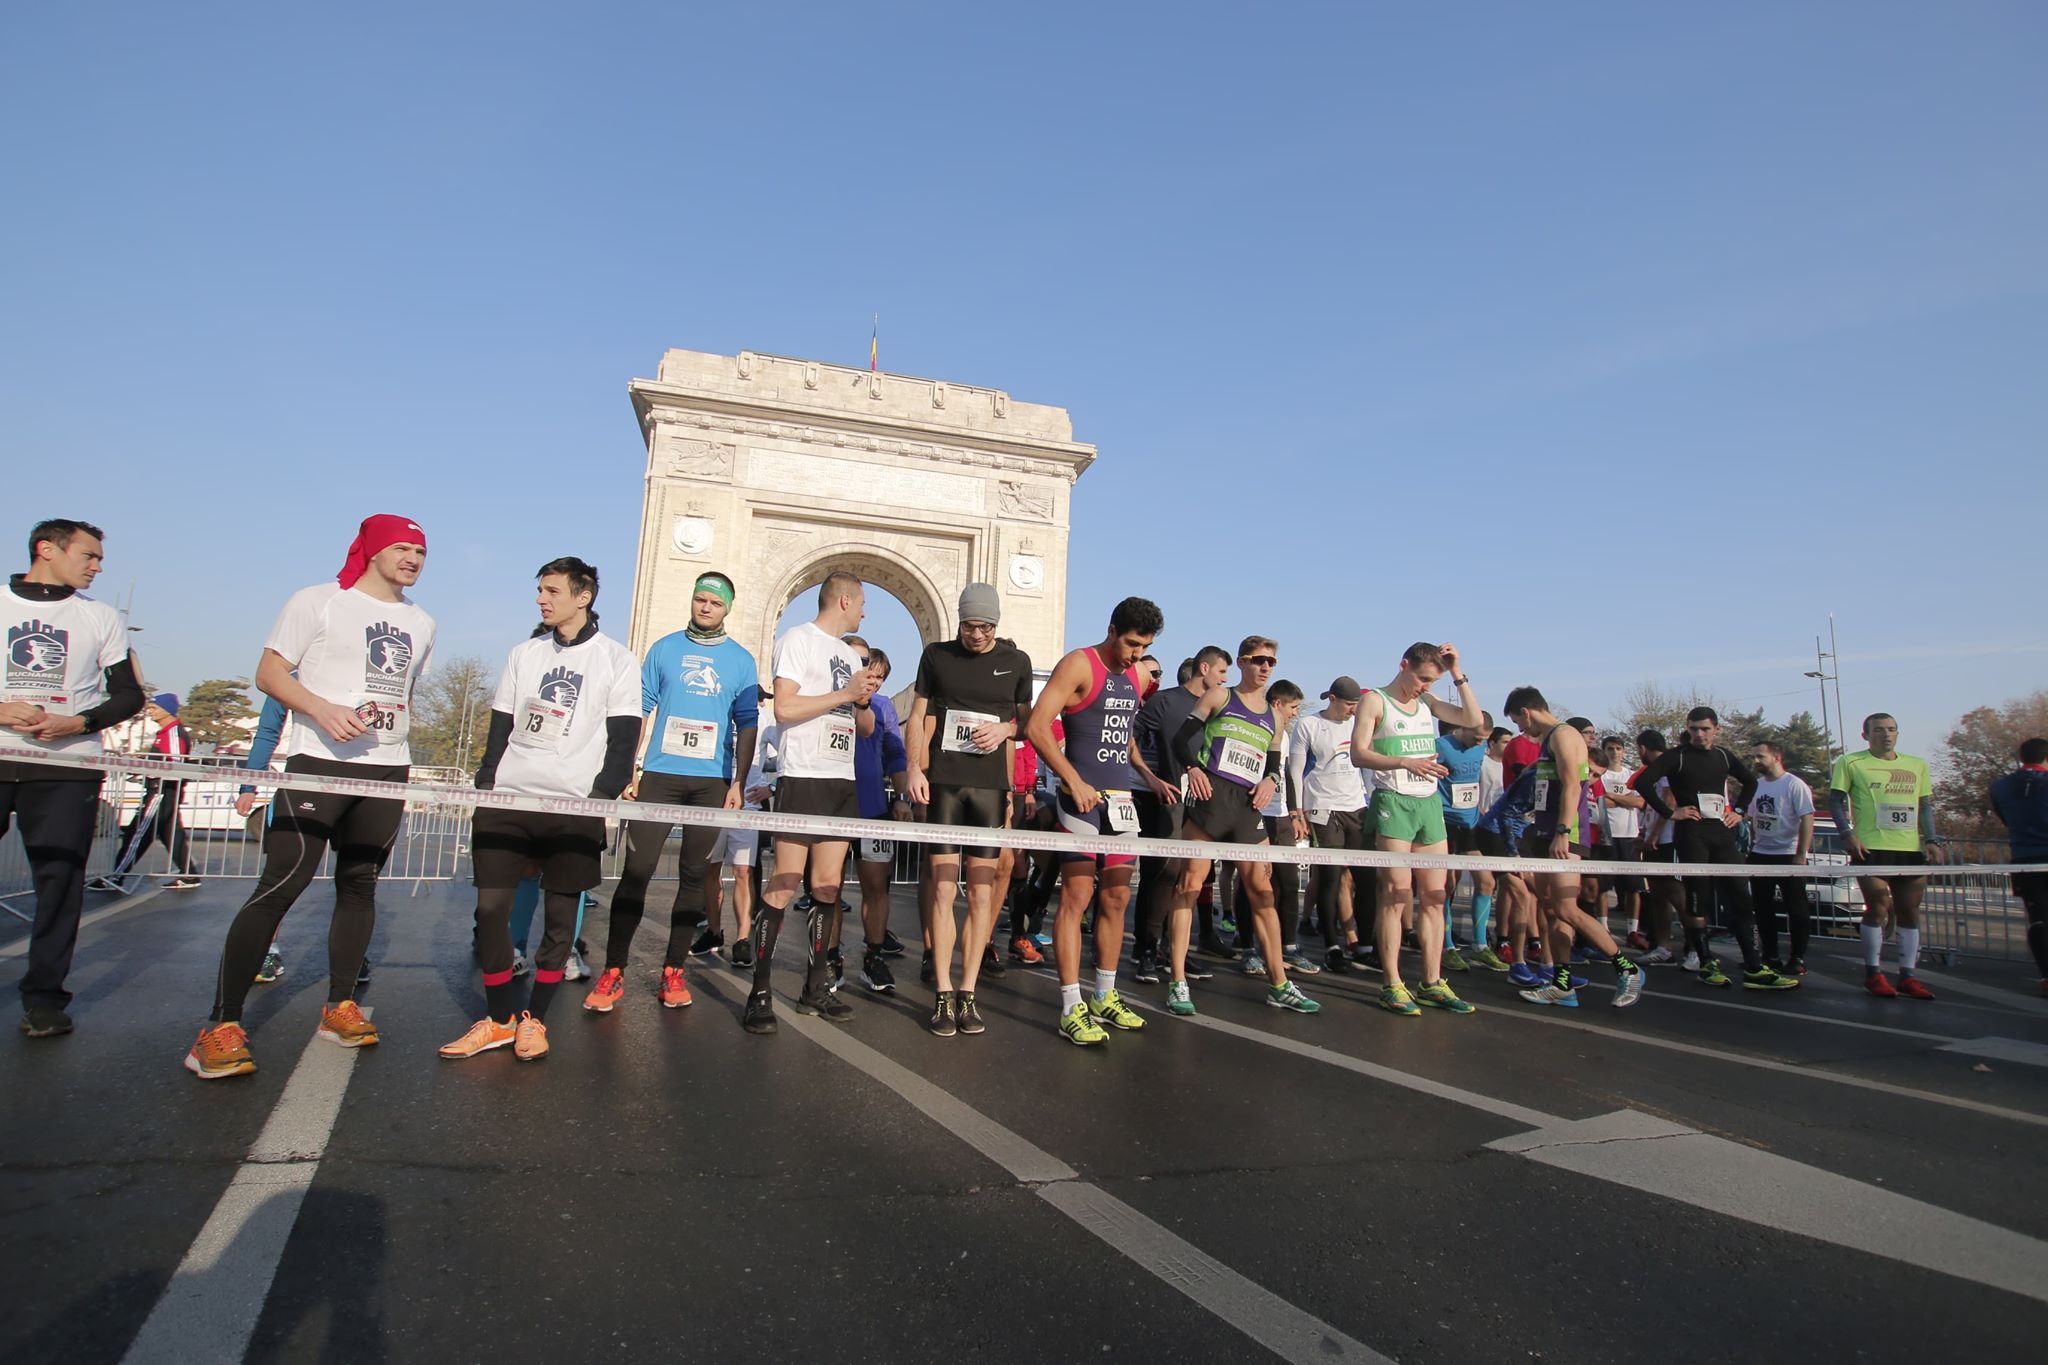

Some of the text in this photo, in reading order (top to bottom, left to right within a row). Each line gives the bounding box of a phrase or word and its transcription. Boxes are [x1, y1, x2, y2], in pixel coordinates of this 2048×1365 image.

[7, 671, 65, 680] BUCHAREST
[1104, 714, 1130, 729] ION
[682, 731, 699, 747] 15
[956, 725, 976, 741] RA
[1101, 729, 1128, 745] ROU
[830, 732, 850, 751] 256
[1227, 750, 1260, 775] NECULA
[1462, 791, 1473, 802] 23
[1118, 805, 1134, 823] 122
[1892, 811, 1908, 824] 93
